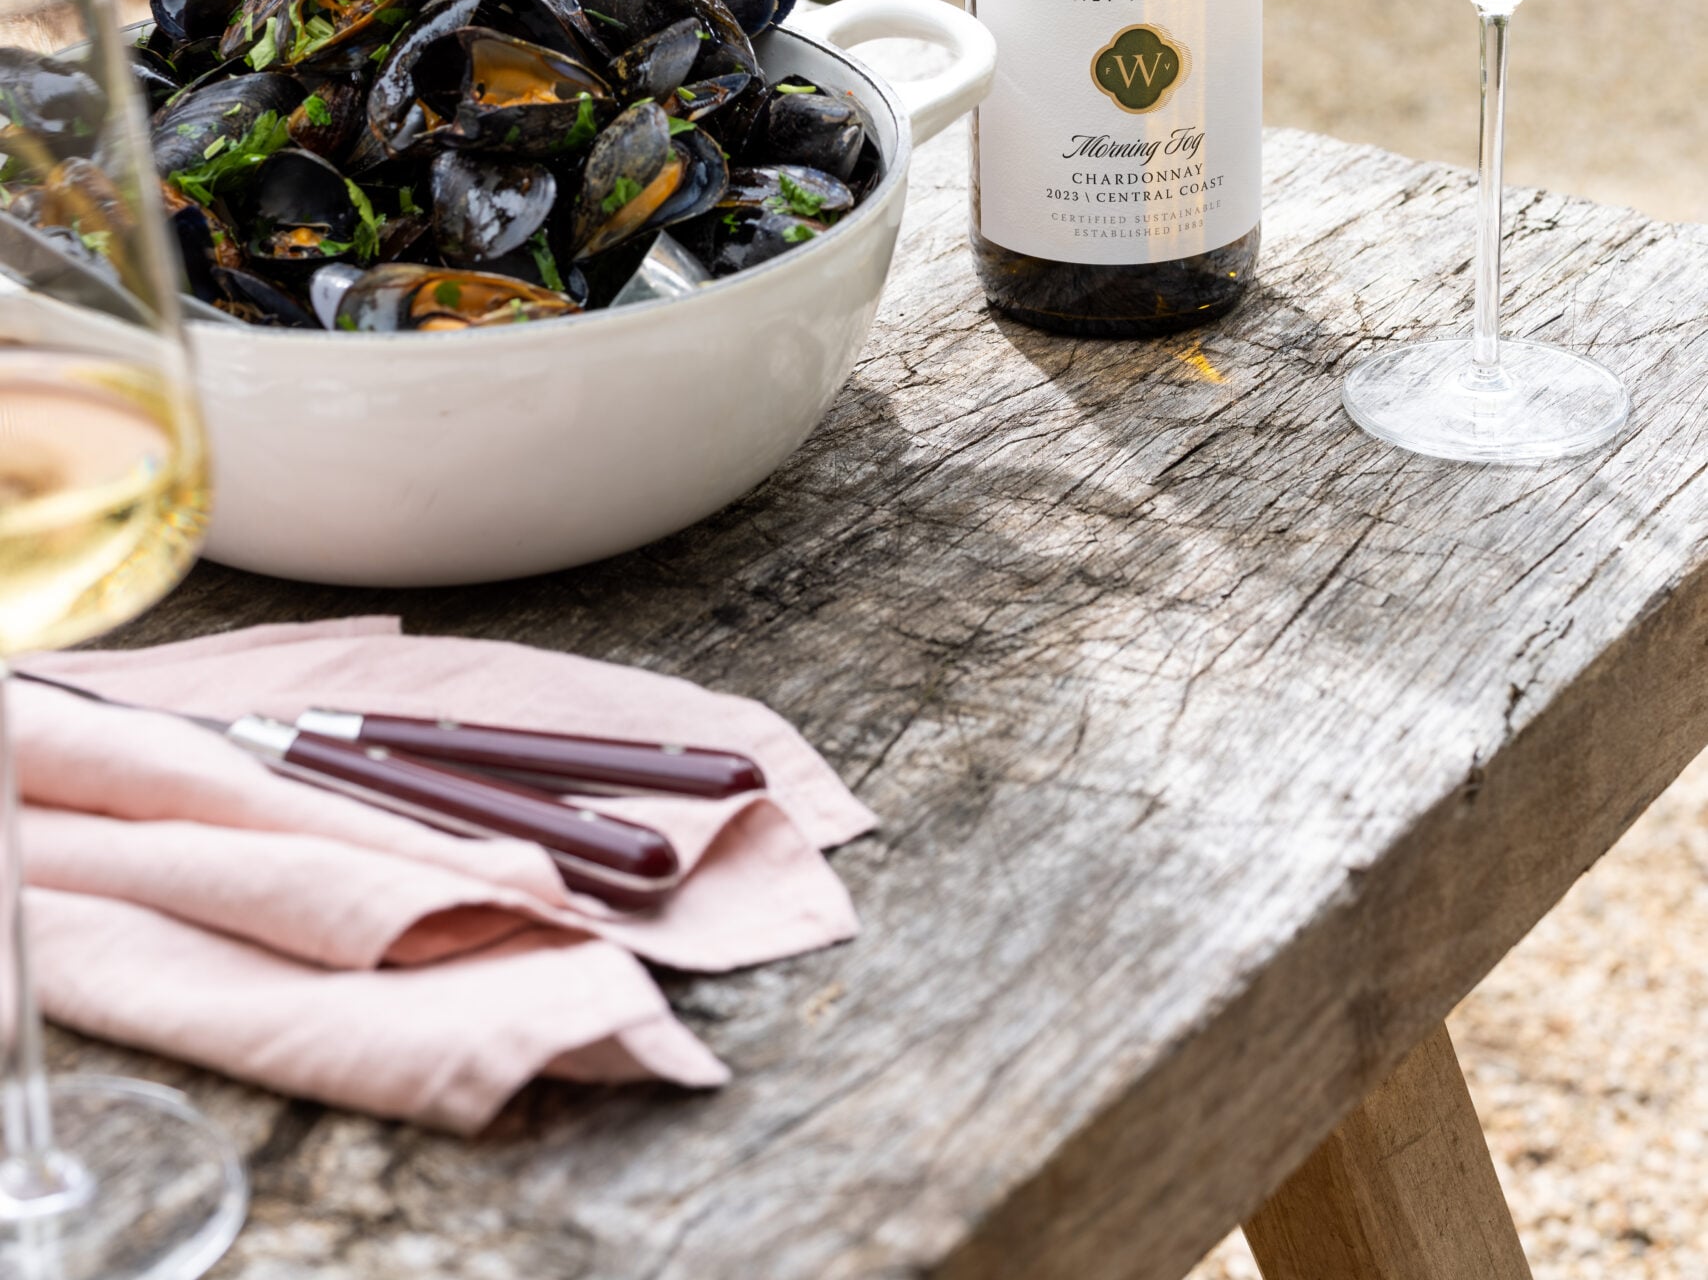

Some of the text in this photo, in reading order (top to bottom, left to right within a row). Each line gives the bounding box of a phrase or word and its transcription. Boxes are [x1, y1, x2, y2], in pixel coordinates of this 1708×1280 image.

[1112, 52, 1164, 89] W
[1062, 126, 1206, 166] Morning Fog
[1072, 163, 1204, 185] CHARDONNAY
[1046, 188, 1079, 202] 2023
[1096, 188, 1173, 203] CENTRAL
[1179, 175, 1225, 196] COAST
[1051, 200, 1222, 224] CERTIFIED SUSTAINABLE
[1074, 220, 1204, 238] ESTABLISHED 1883
